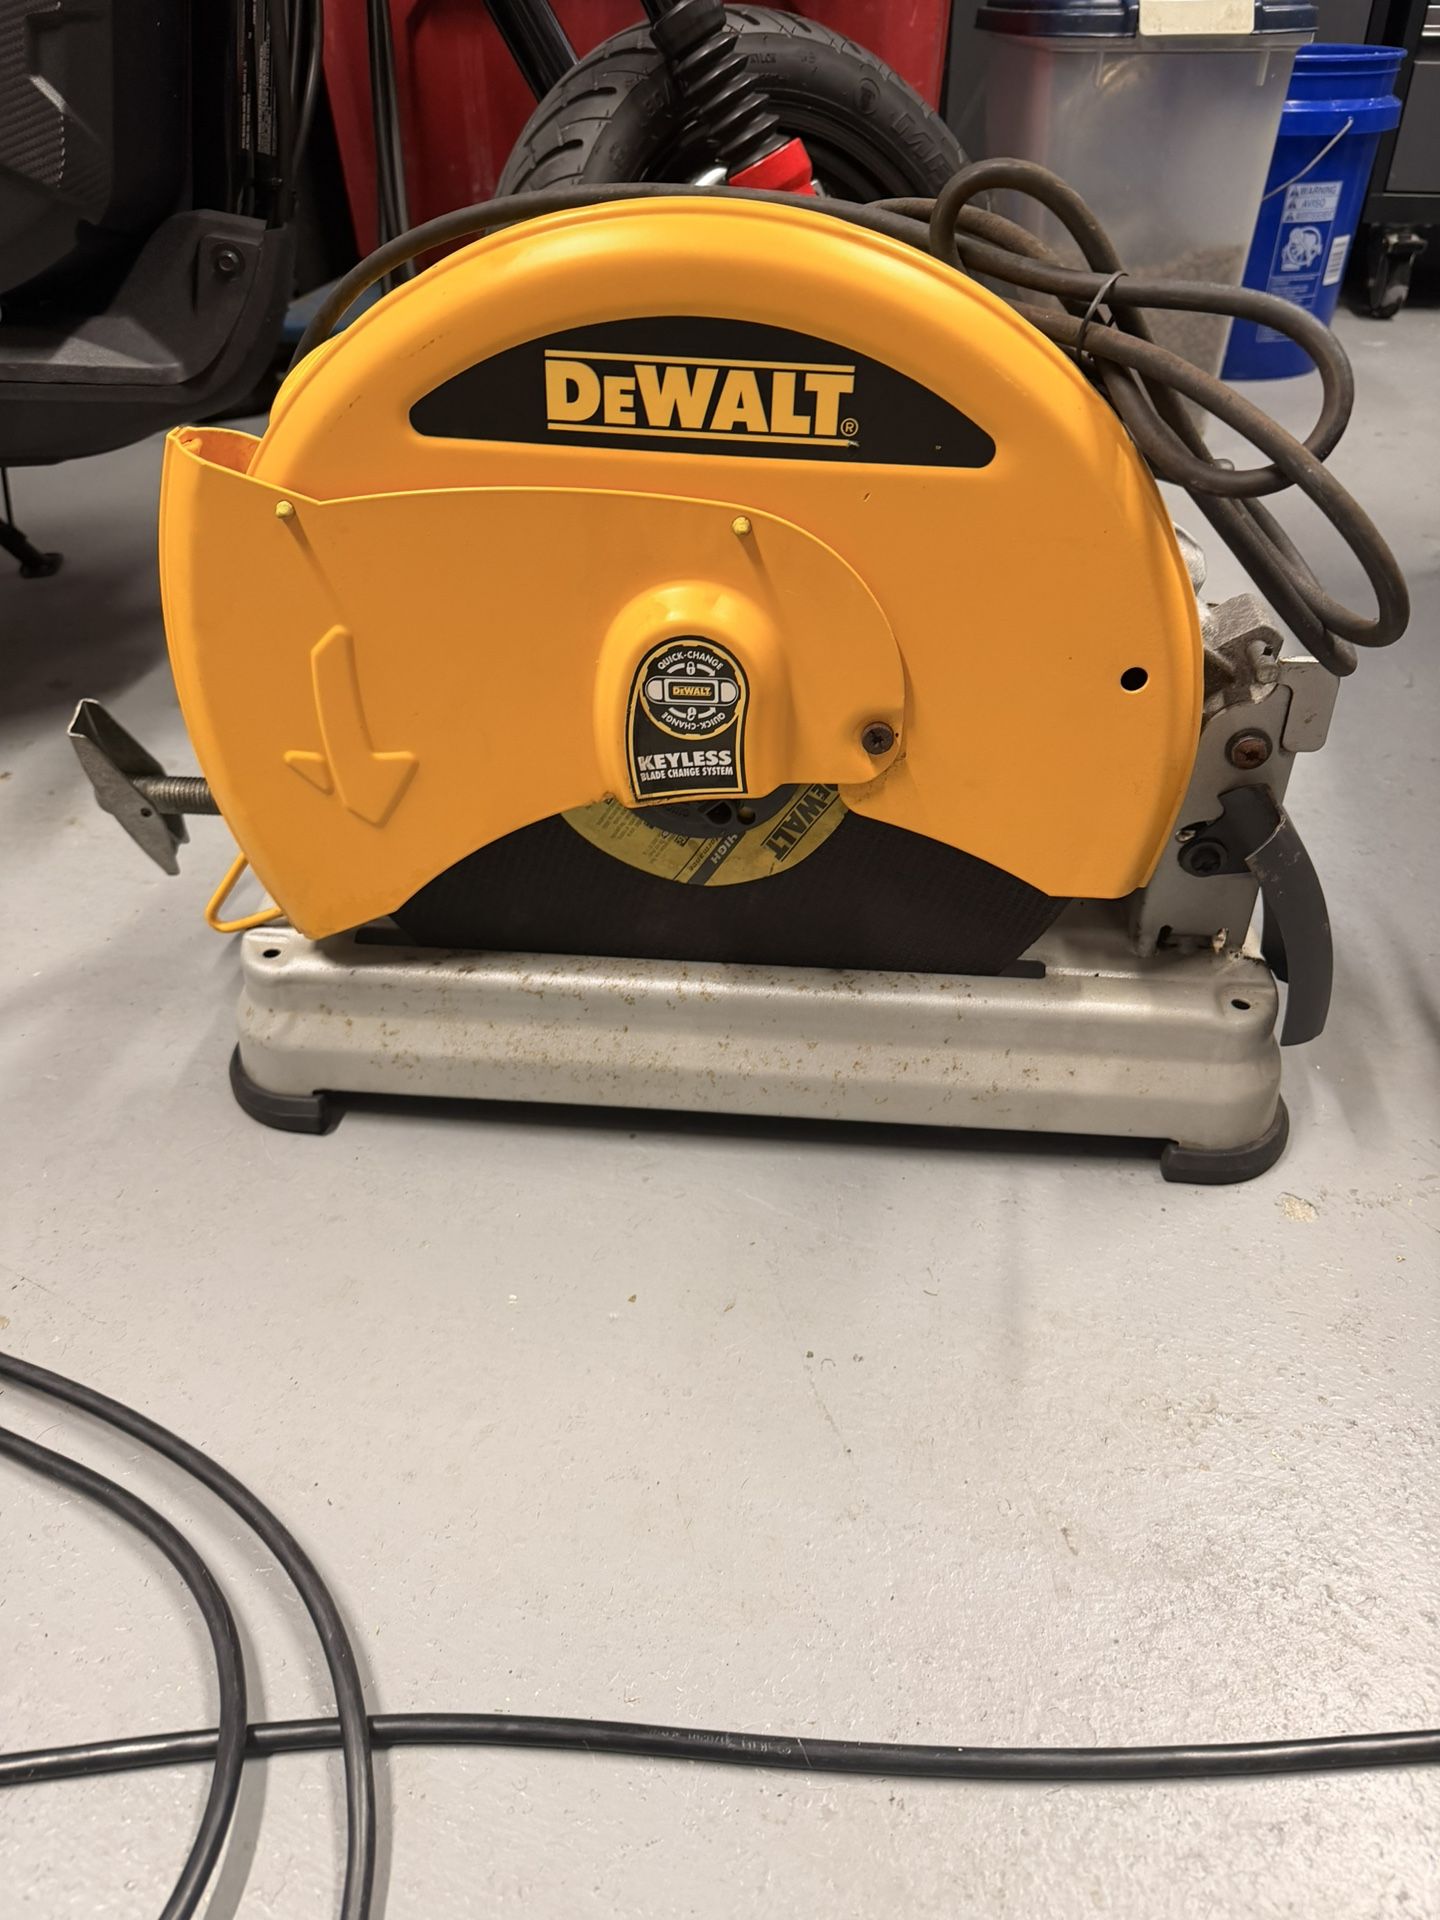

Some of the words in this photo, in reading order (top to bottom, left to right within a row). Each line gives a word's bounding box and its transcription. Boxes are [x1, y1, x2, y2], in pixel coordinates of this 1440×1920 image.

[544, 359, 855, 437] DEWALT
[657, 650, 724, 671] QUICK-CHANGE
[672, 686, 711, 696] DEWALT
[661, 711, 726, 730] QUICK-CHANGE
[637, 750, 732, 771] KEYLESS
[640, 770, 666, 782] BLADE
[667, 768, 700, 778] CHANGE
[702, 766, 734, 776] SYSTEM
